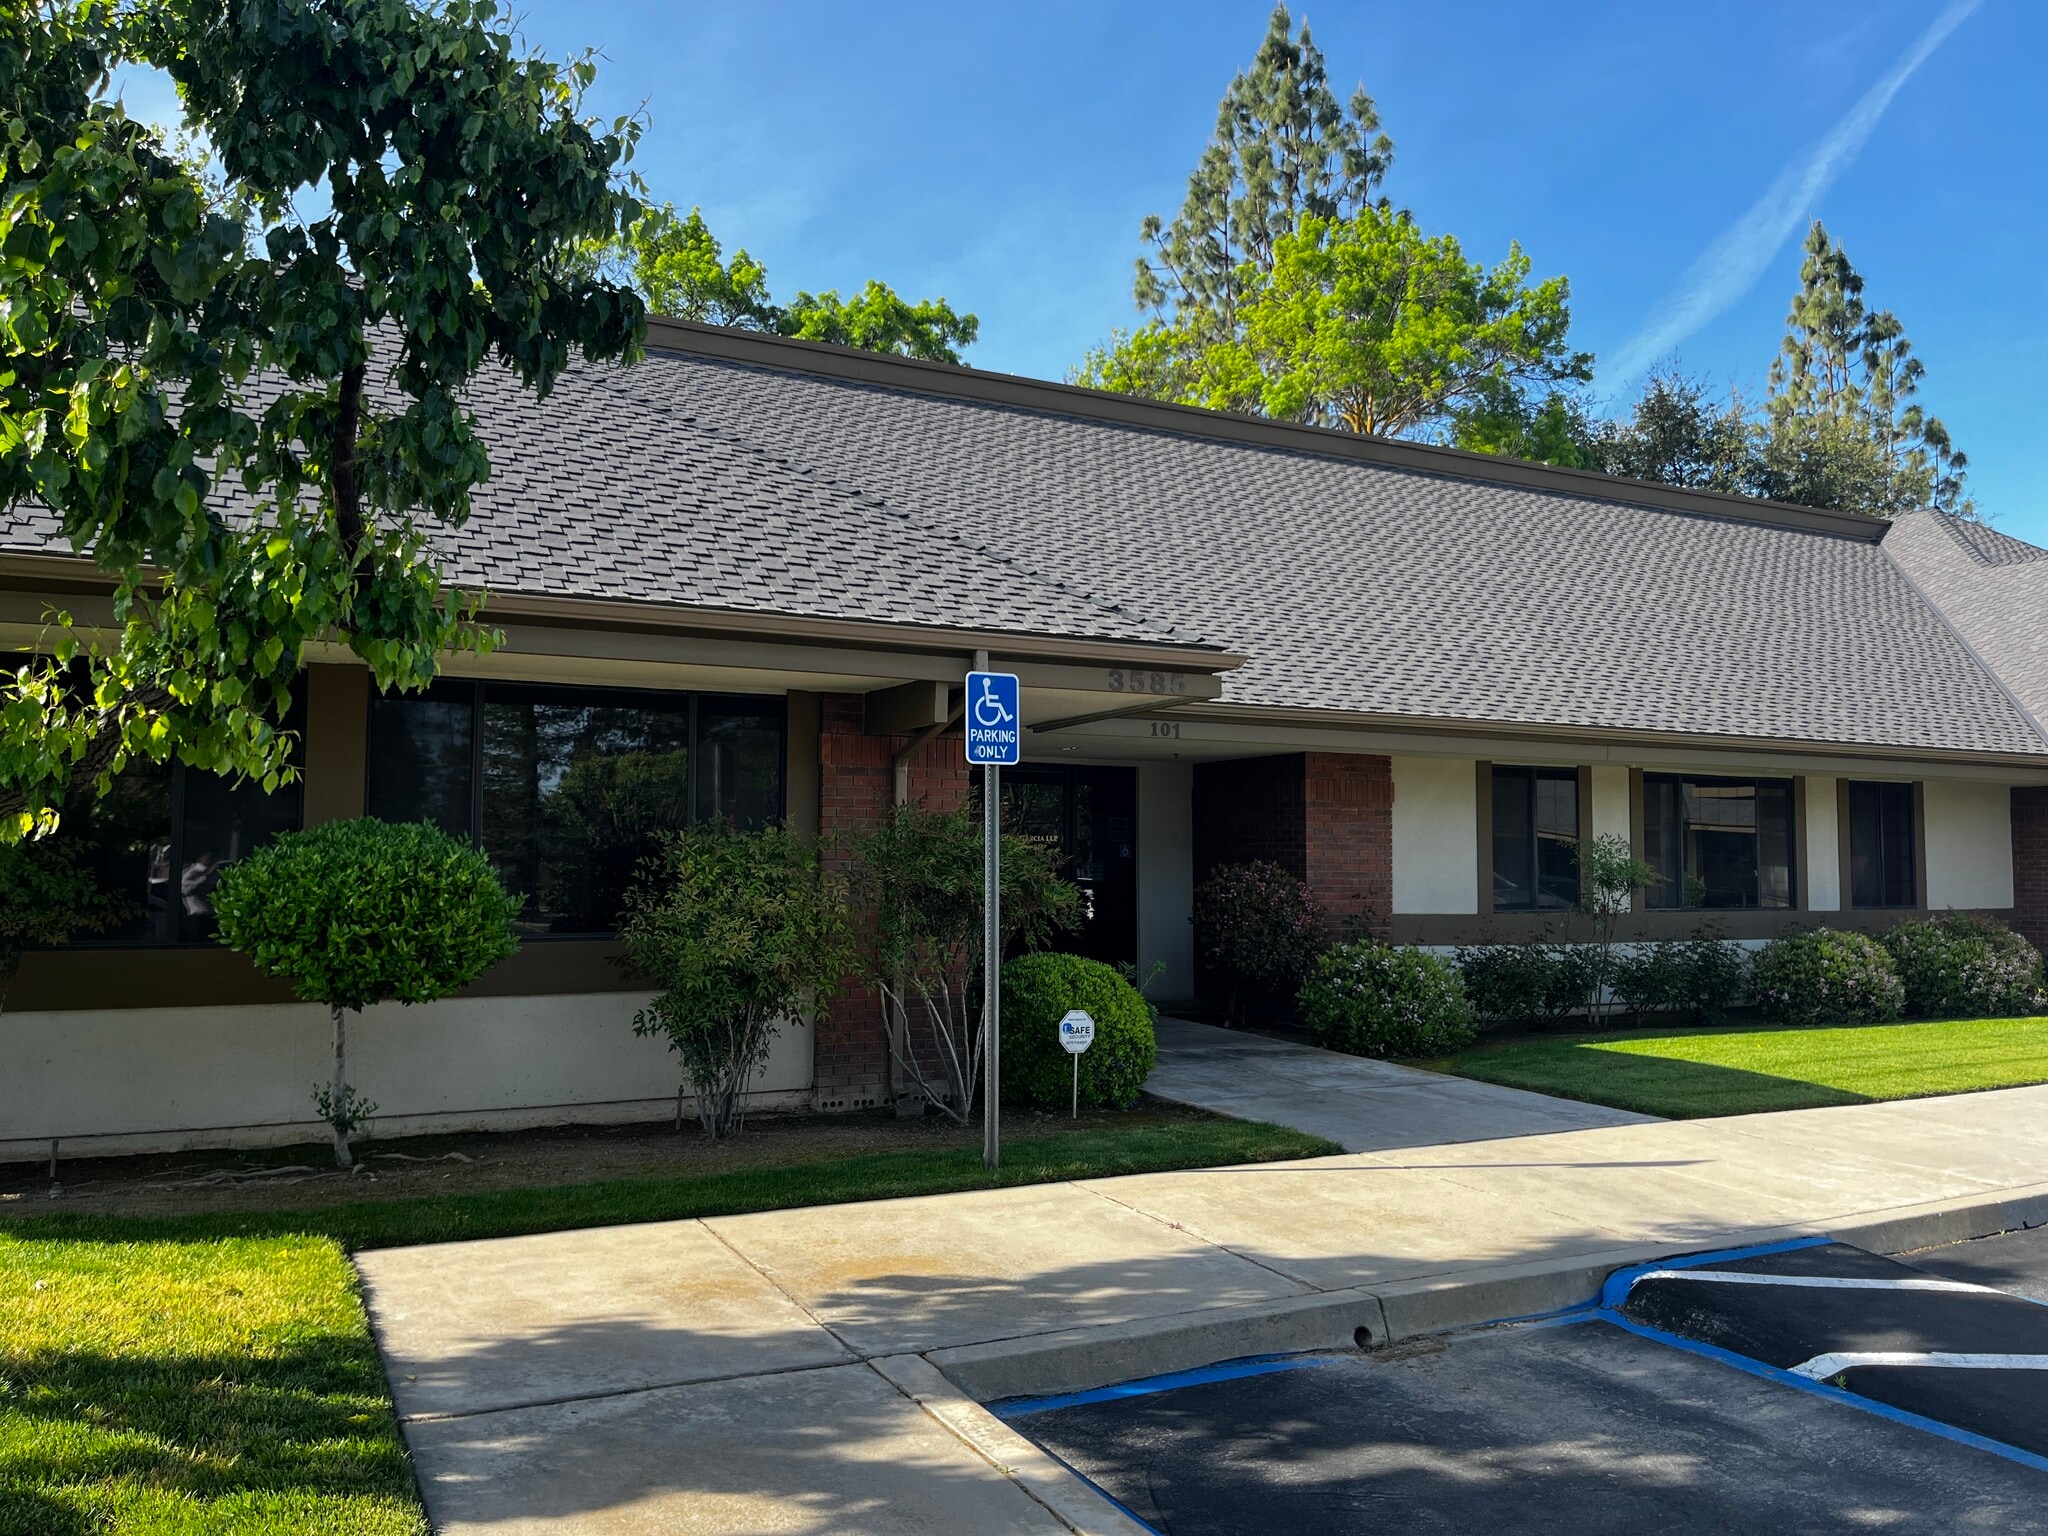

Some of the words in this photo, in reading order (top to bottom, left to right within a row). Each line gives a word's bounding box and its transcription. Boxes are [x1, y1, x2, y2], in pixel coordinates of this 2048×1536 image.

[1109, 669, 1185, 694] 3585
[971, 729, 1015, 743] PARKING
[1151, 722, 1180, 739] 101
[979, 745, 1008, 758] ONLY
